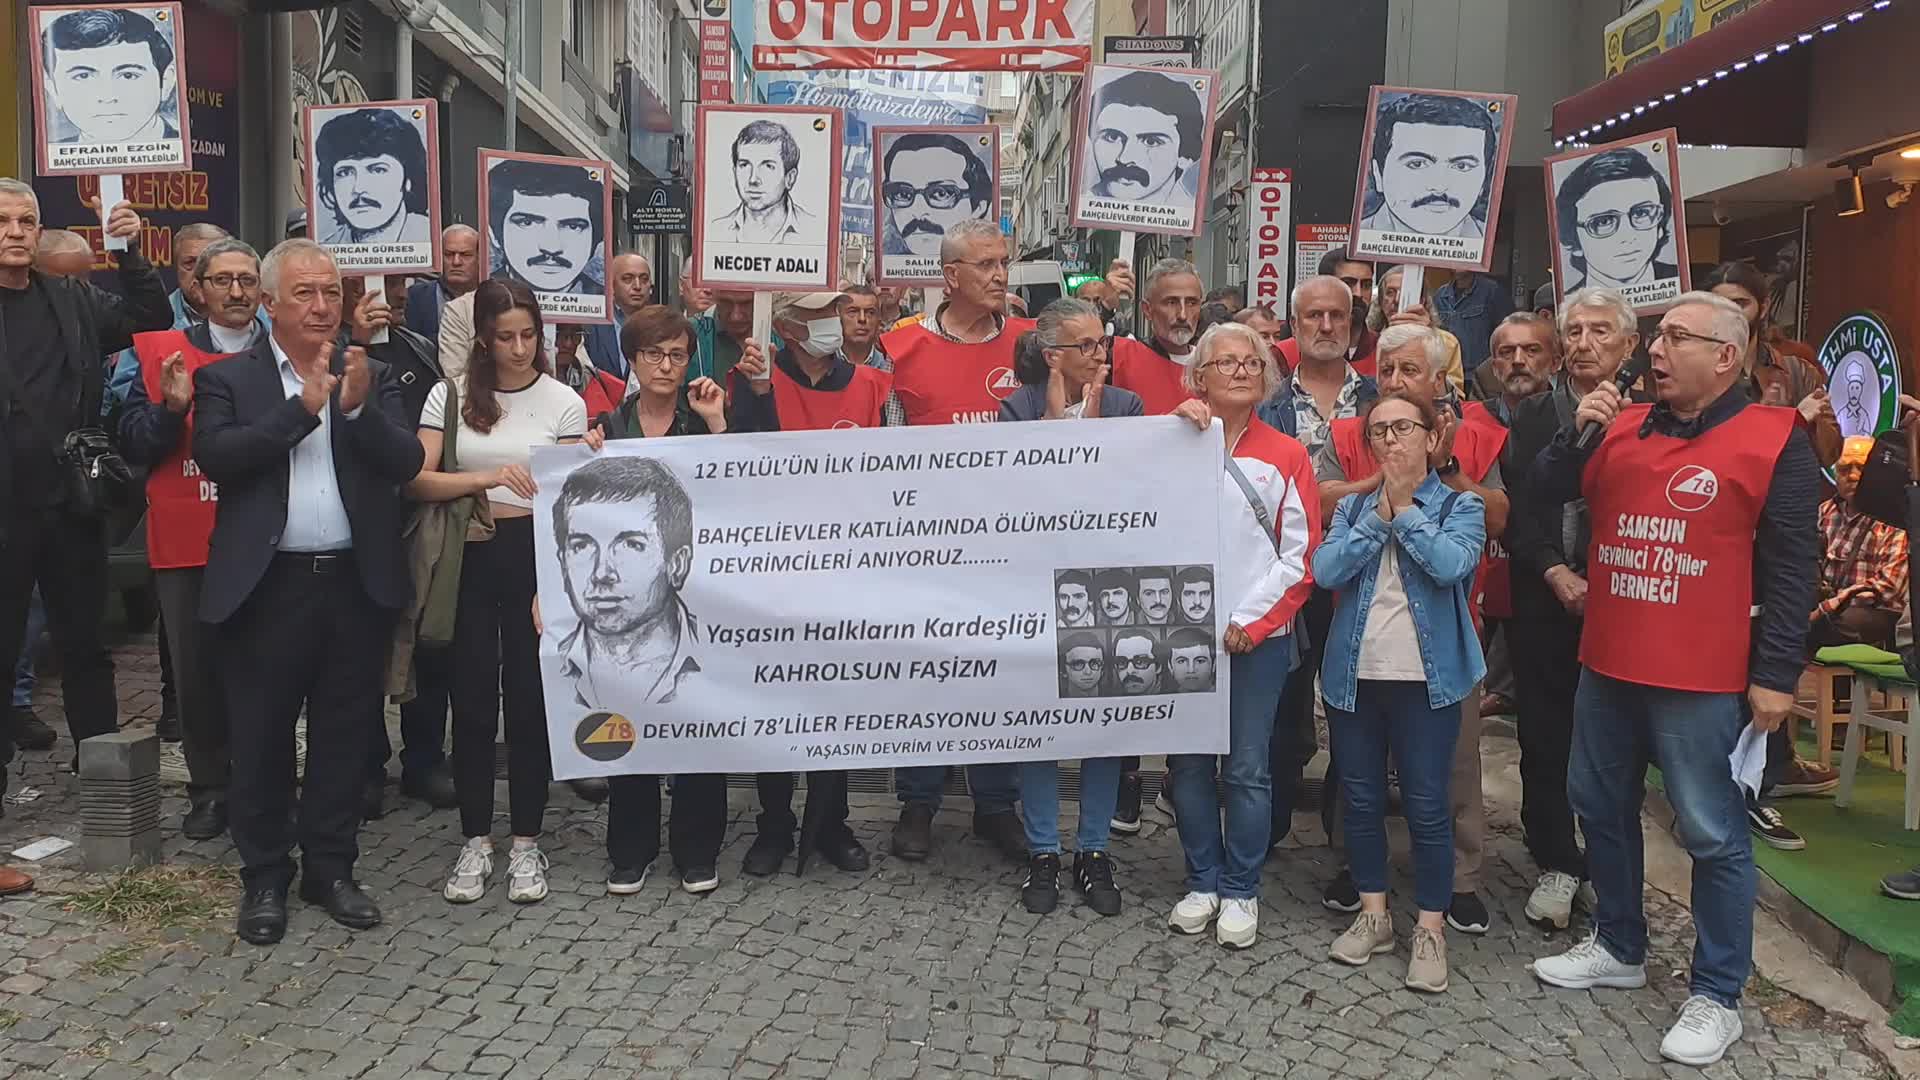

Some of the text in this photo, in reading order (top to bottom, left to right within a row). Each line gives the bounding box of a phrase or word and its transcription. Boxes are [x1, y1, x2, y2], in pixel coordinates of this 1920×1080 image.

[769, 0, 1075, 41] OTOPARK
[1115, 40, 1184, 50] SHADOWS
[208, 91, 223, 108] VE
[59, 143, 171, 156] EFRAİM EZGİN
[53, 153, 179, 168] BAHÇELİEVLERDE KATLEDİLDİ
[1088, 200, 1176, 215] FARUK ERSAN
[1081, 210, 1190, 228] BAHÇELİEVLERDE KATLEDİLDİ
[1381, 233, 1464, 247] SERDAR ALTEN
[372, 245, 415, 254] GÜRSES
[1361, 243, 1478, 260] BAHÇELİEVLERDE KATLEDİLDİ
[386, 255, 428, 264] KATLEDİLDİ
[714, 255, 818, 273] NECDET ADALI
[905, 258, 934, 266] SALİH
[886, 268, 944, 277] BAHÇELİEVLERD
[553, 295, 578, 303] CAN
[1633, 289, 1677, 304] KATLEDİLDİ
[560, 304, 602, 314] KATLEDİLDİ
[1863, 327, 1893, 394] USTA
[694, 446, 1100, 480] 12 EYLÜL'ÜN İLK İDAMI NECDET ADALI'YI
[1693, 478, 1714, 494] 78
[892, 490, 917, 506] VE
[697, 510, 1157, 547] BAHÇELİEVLER KATLİAMINDA ÖLÜMSÜZLEŞEN
[1617, 513, 1687, 544] SAMSUN
[709, 549, 852, 574] DEVRİMCİLERİ
[1598, 543, 1708, 577] DEVRİMCİ 78'liler
[1610, 571, 1680, 604] DERNEĞİ
[707, 613, 1048, 648] Yaşasın Halkların Kardeşliği
[754, 656, 998, 684] KAHROLSUN FAŞİZM
[643, 700, 1176, 740] DEVRİMCİ 78'LİLER FEDERASYONU SAMSUN ŞUBESİ
[603, 722, 633, 740] 78
[806, 735, 1042, 760] YAŞASIN DEVRİM VE SOSYALİZM
